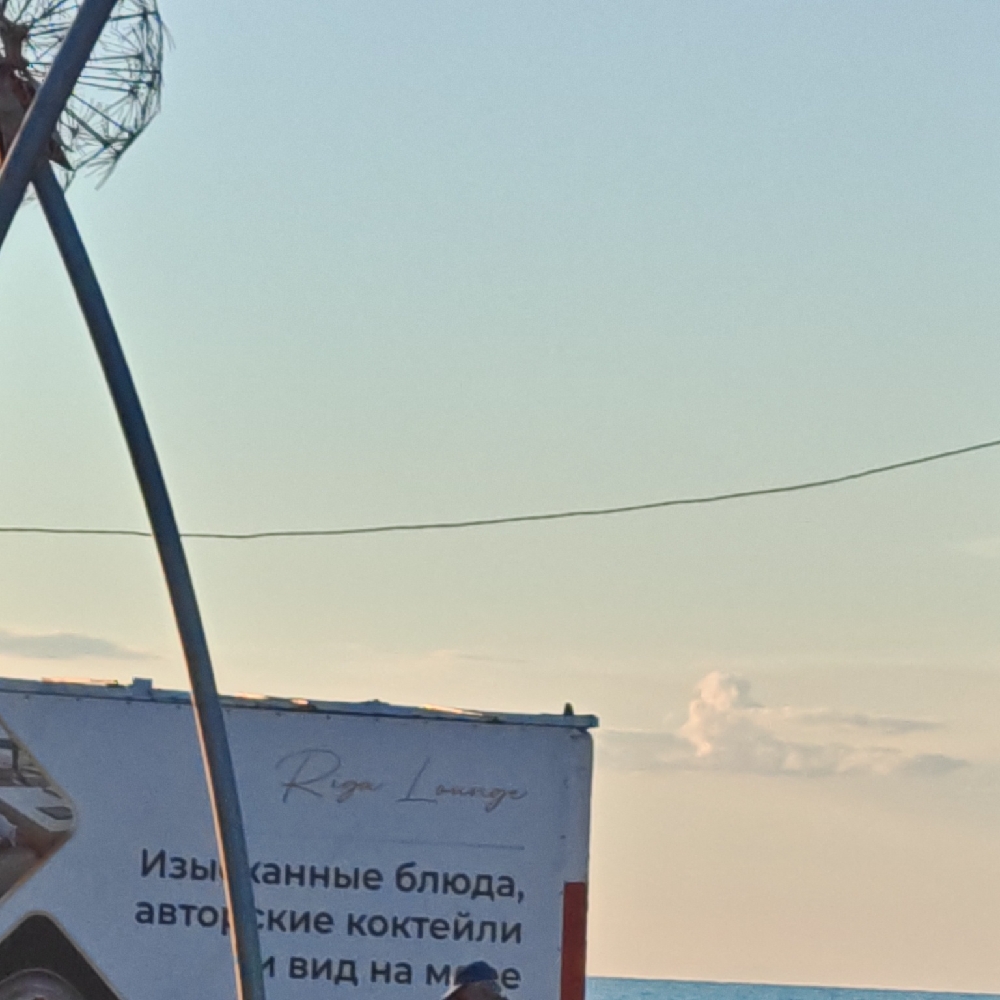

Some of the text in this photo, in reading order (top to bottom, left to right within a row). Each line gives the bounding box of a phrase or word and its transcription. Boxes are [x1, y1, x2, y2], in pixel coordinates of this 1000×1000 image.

[395, 756, 528, 813] Lounge
[141, 848, 524, 902] Изыканные блюда,
[347, 910, 522, 944] коктейли
[288, 956, 359, 986] вид
[371, 960, 413, 985] на
[425, 963, 522, 990] ме
